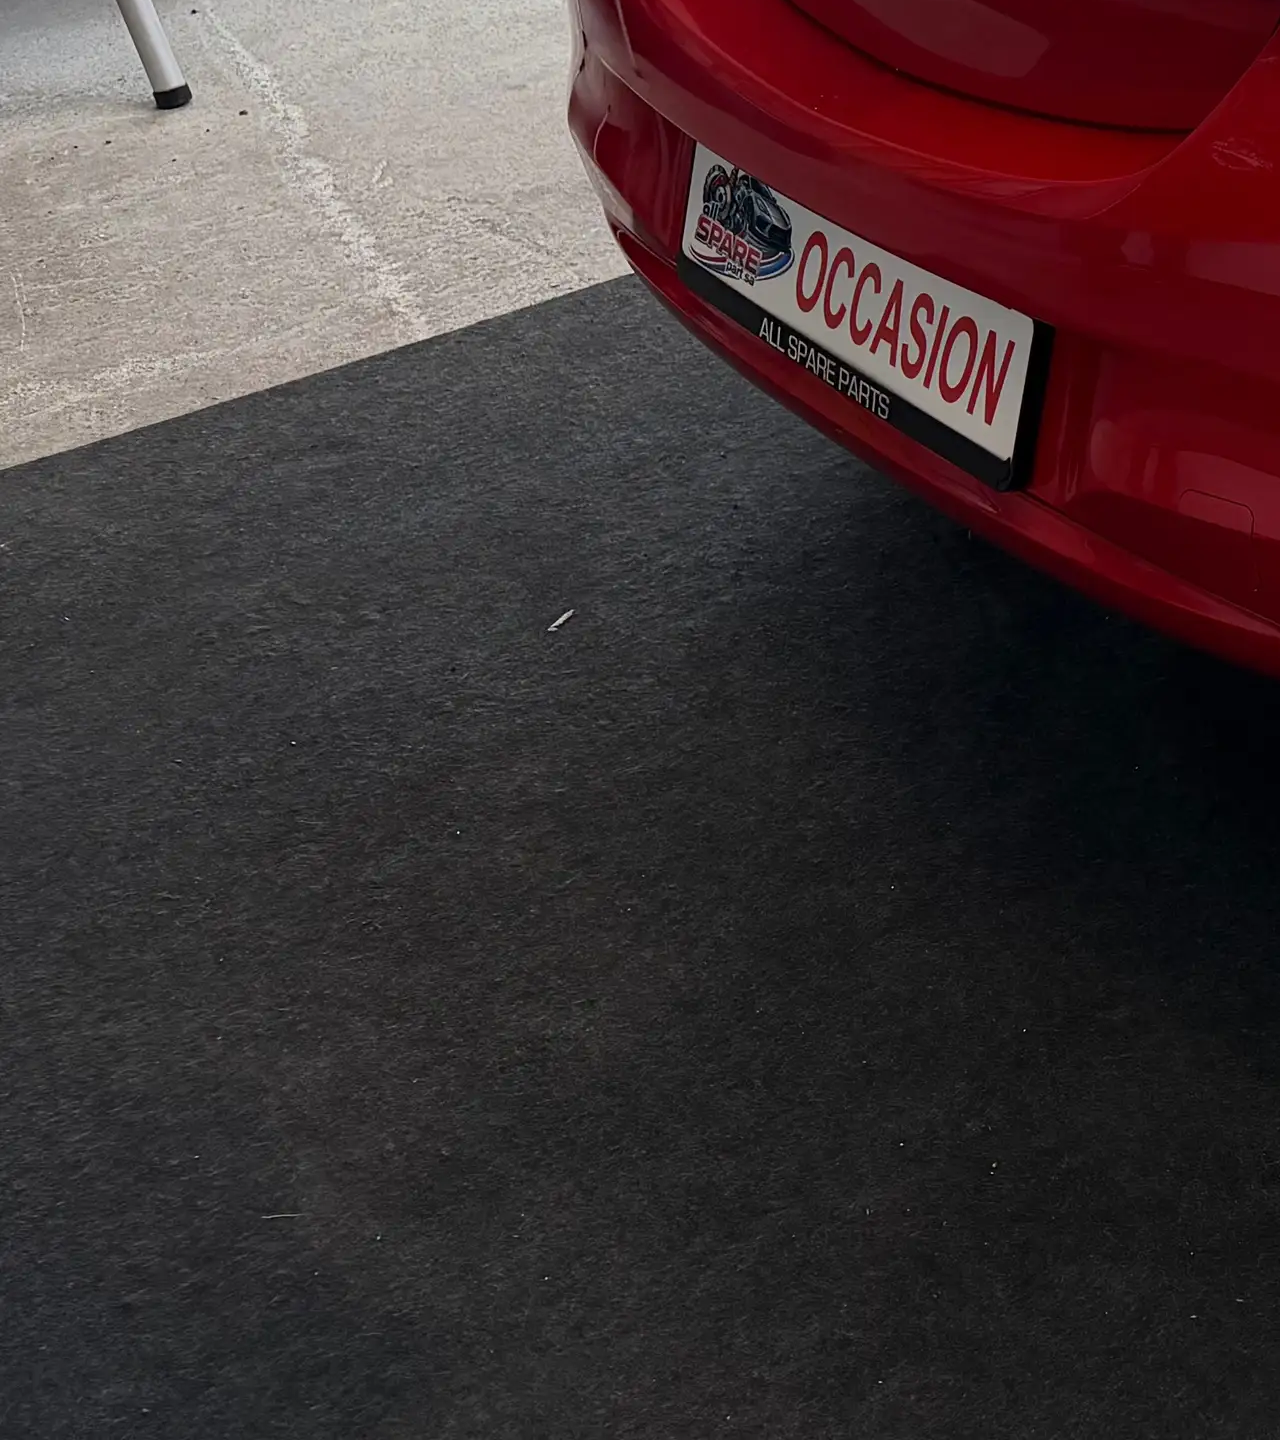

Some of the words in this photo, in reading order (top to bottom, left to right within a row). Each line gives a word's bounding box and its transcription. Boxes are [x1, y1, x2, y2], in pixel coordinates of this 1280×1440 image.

[695, 214, 763, 277] SPARE
[759, 317, 785, 354] ALL
[787, 334, 837, 386] SPARE
[838, 367, 890, 420] PARTS
[796, 231, 1016, 426] OCCASION
